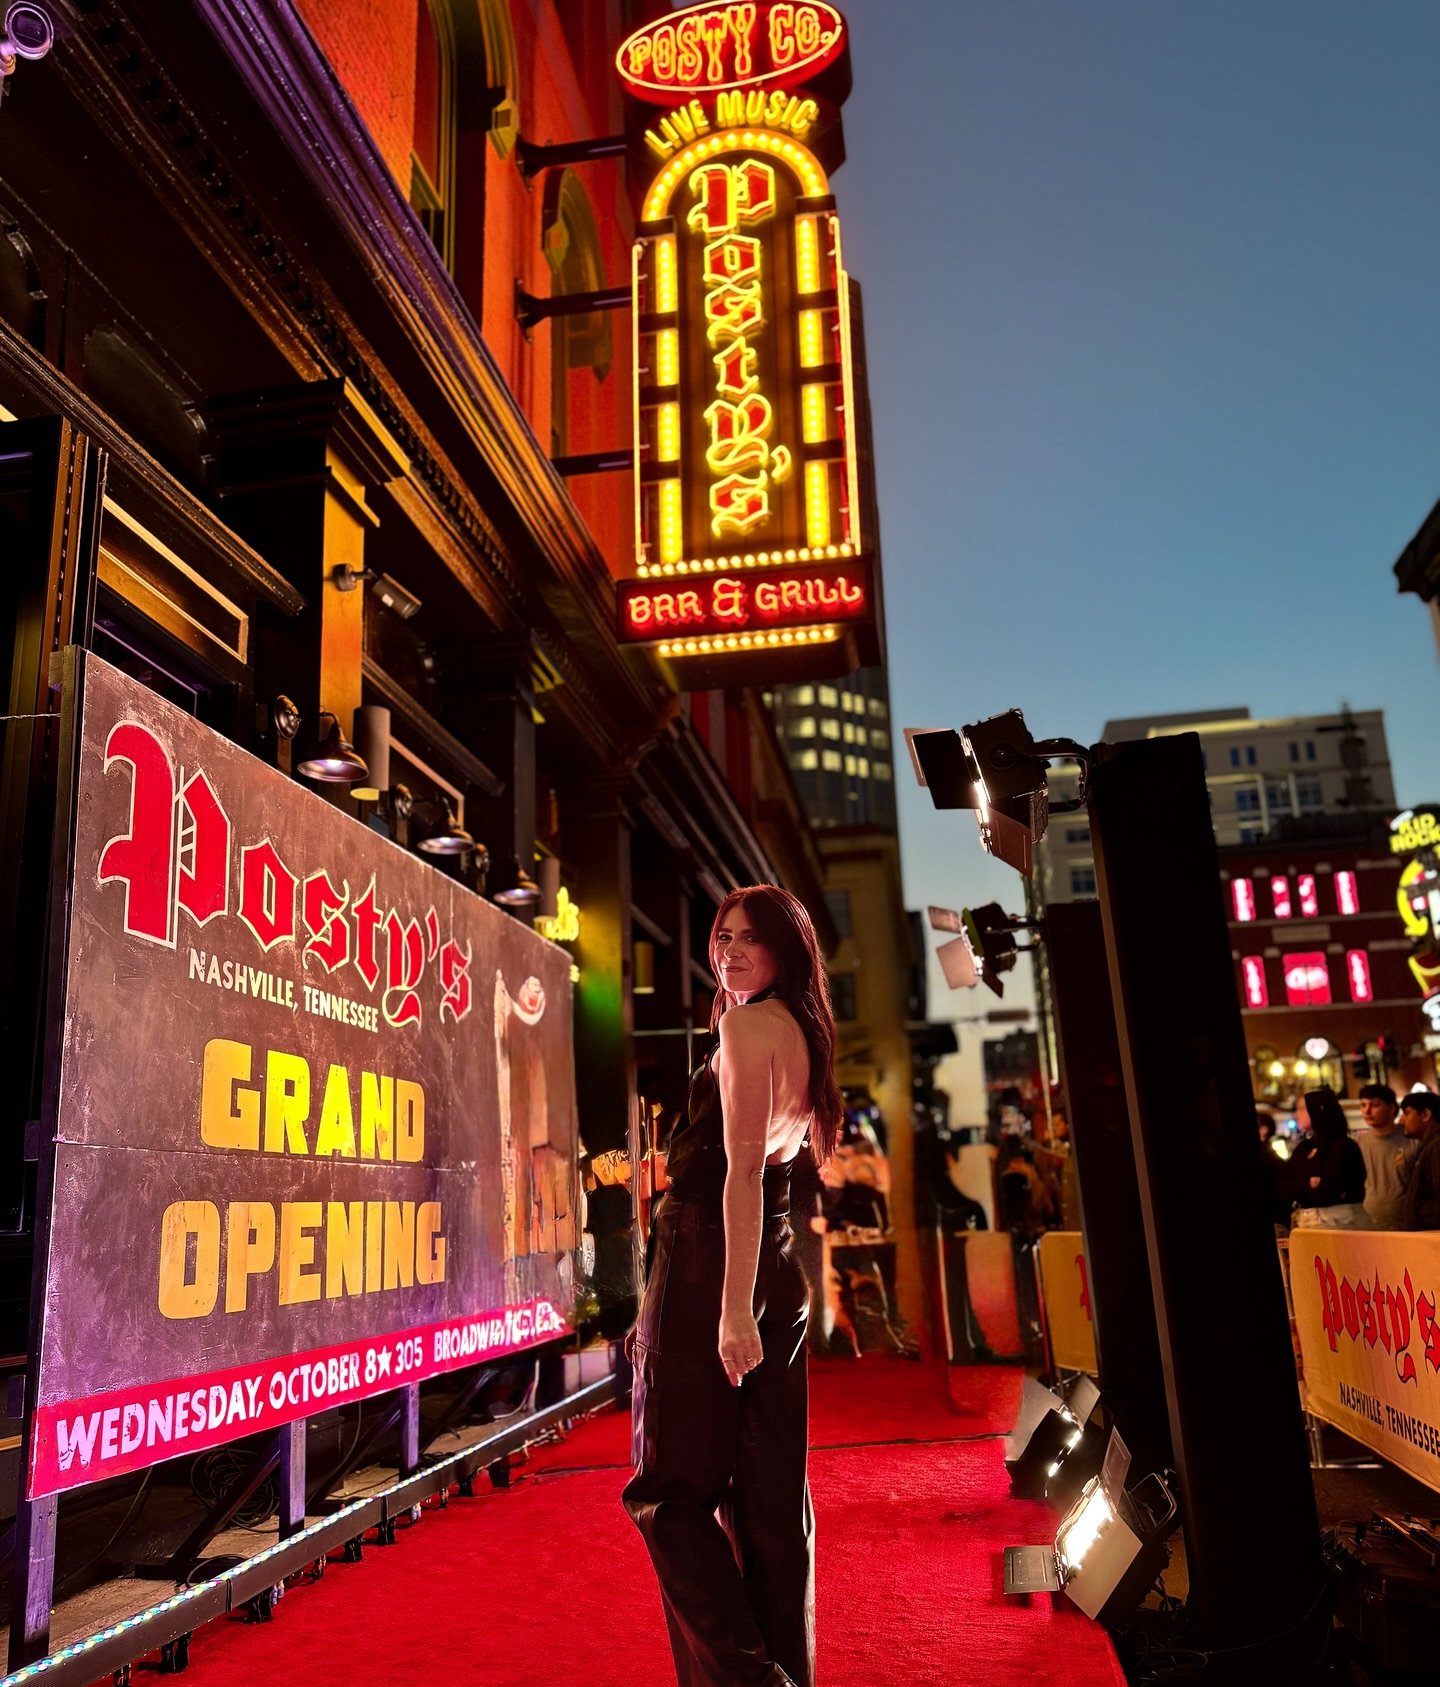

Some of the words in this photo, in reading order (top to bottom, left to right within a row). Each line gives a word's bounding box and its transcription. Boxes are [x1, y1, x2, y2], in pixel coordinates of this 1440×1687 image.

[628, 3, 756, 82] POSTY
[769, 3, 834, 64] CO.
[644, 99, 709, 156] LIVE
[716, 89, 818, 133] MUSIC
[686, 158, 792, 537] Posty's
[628, 590, 703, 624] BAR
[712, 577, 746, 620] &
[754, 576, 862, 612] GRILL
[98, 719, 473, 1030] Posty's
[188, 948, 299, 1011] NASHVILLE,
[303, 983, 379, 1034] TENNESSEE
[200, 1038, 426, 1163] GRAND
[157, 1199, 446, 1320] OPENING
[55, 1372, 267, 1473] WEDNESDAY,
[268, 1351, 361, 1411] OCTOBER
[1339, 1380, 1385, 1431] NASHVILLE,
[1385, 1404, 1440, 1459] TENNESSEE
